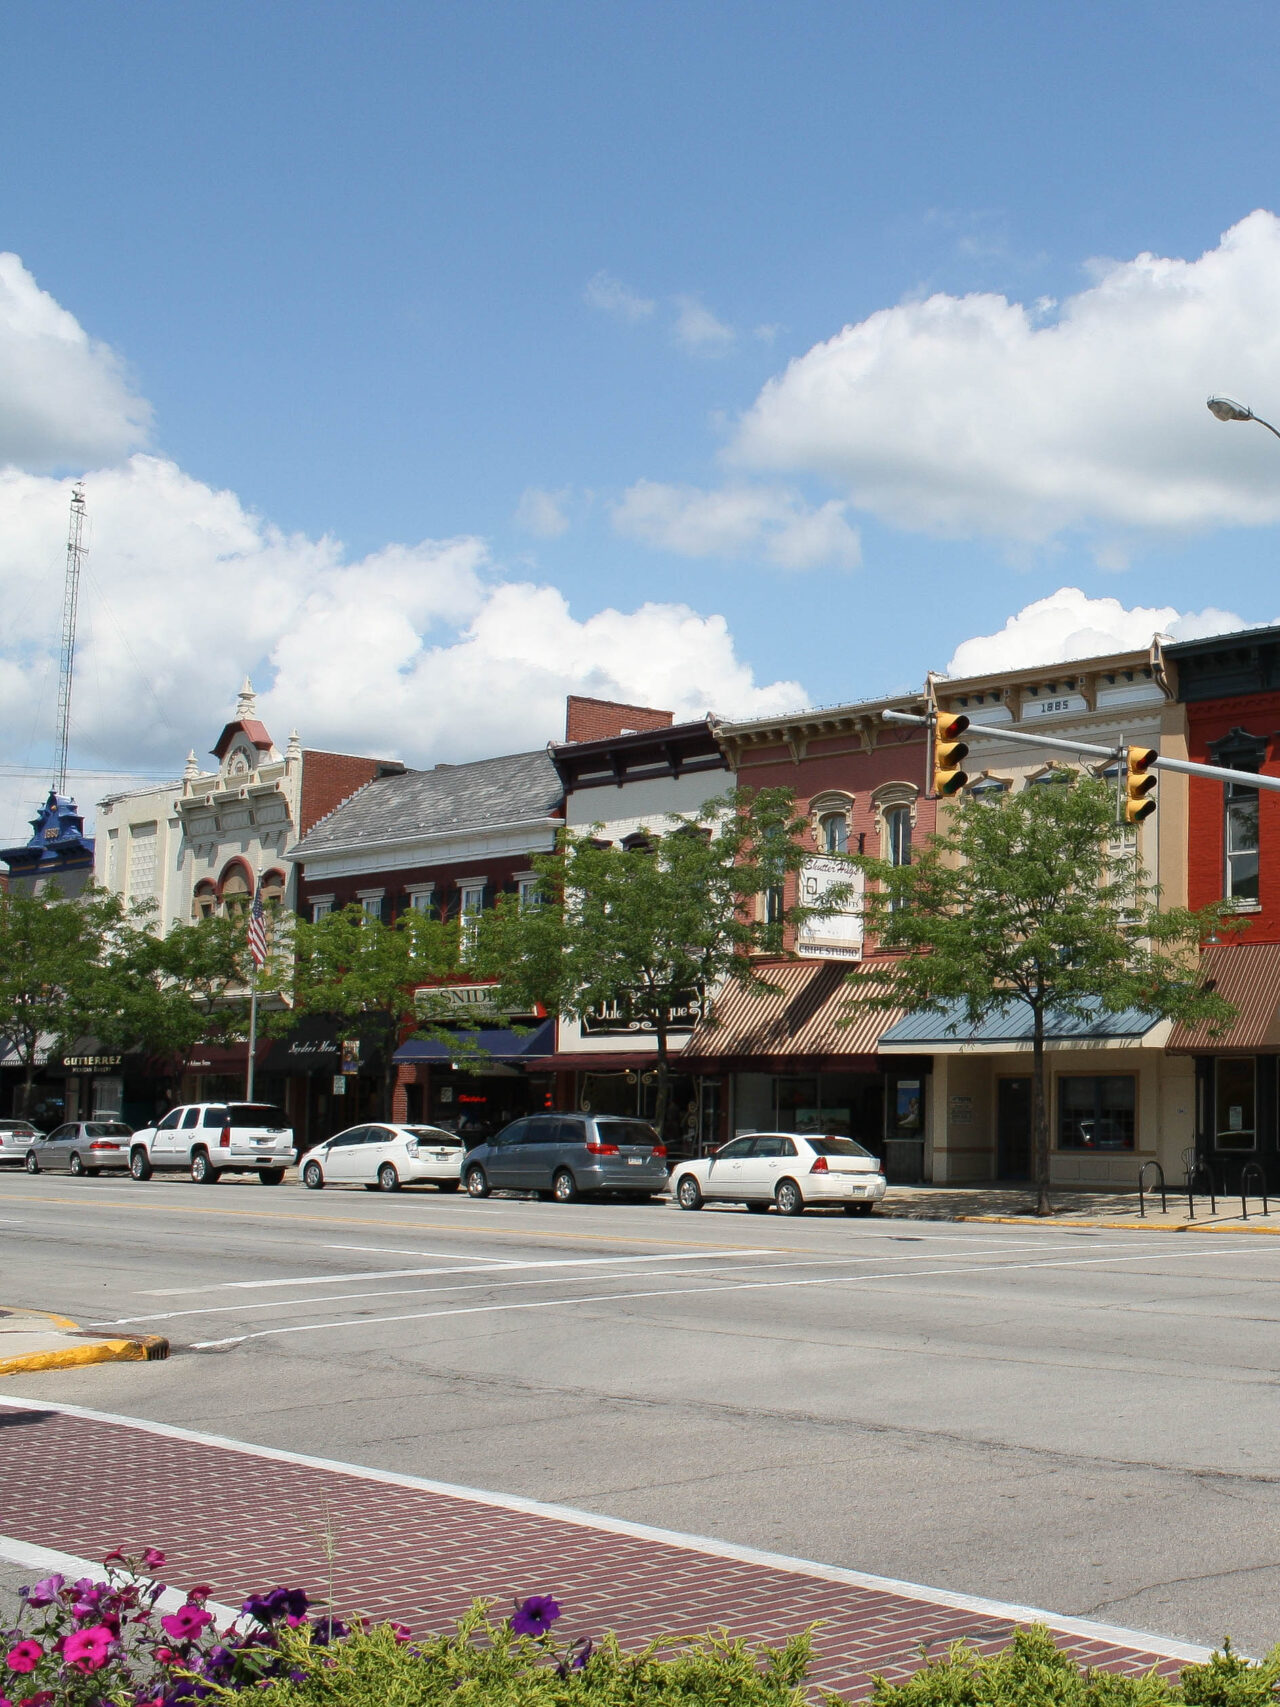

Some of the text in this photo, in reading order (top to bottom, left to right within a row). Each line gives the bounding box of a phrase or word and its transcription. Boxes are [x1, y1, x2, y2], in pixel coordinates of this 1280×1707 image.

[1041, 700, 1069, 713] 1885
[799, 945, 858, 958] CRIPE STUDIO
[63, 1056, 121, 1066] GUTIERREZ
